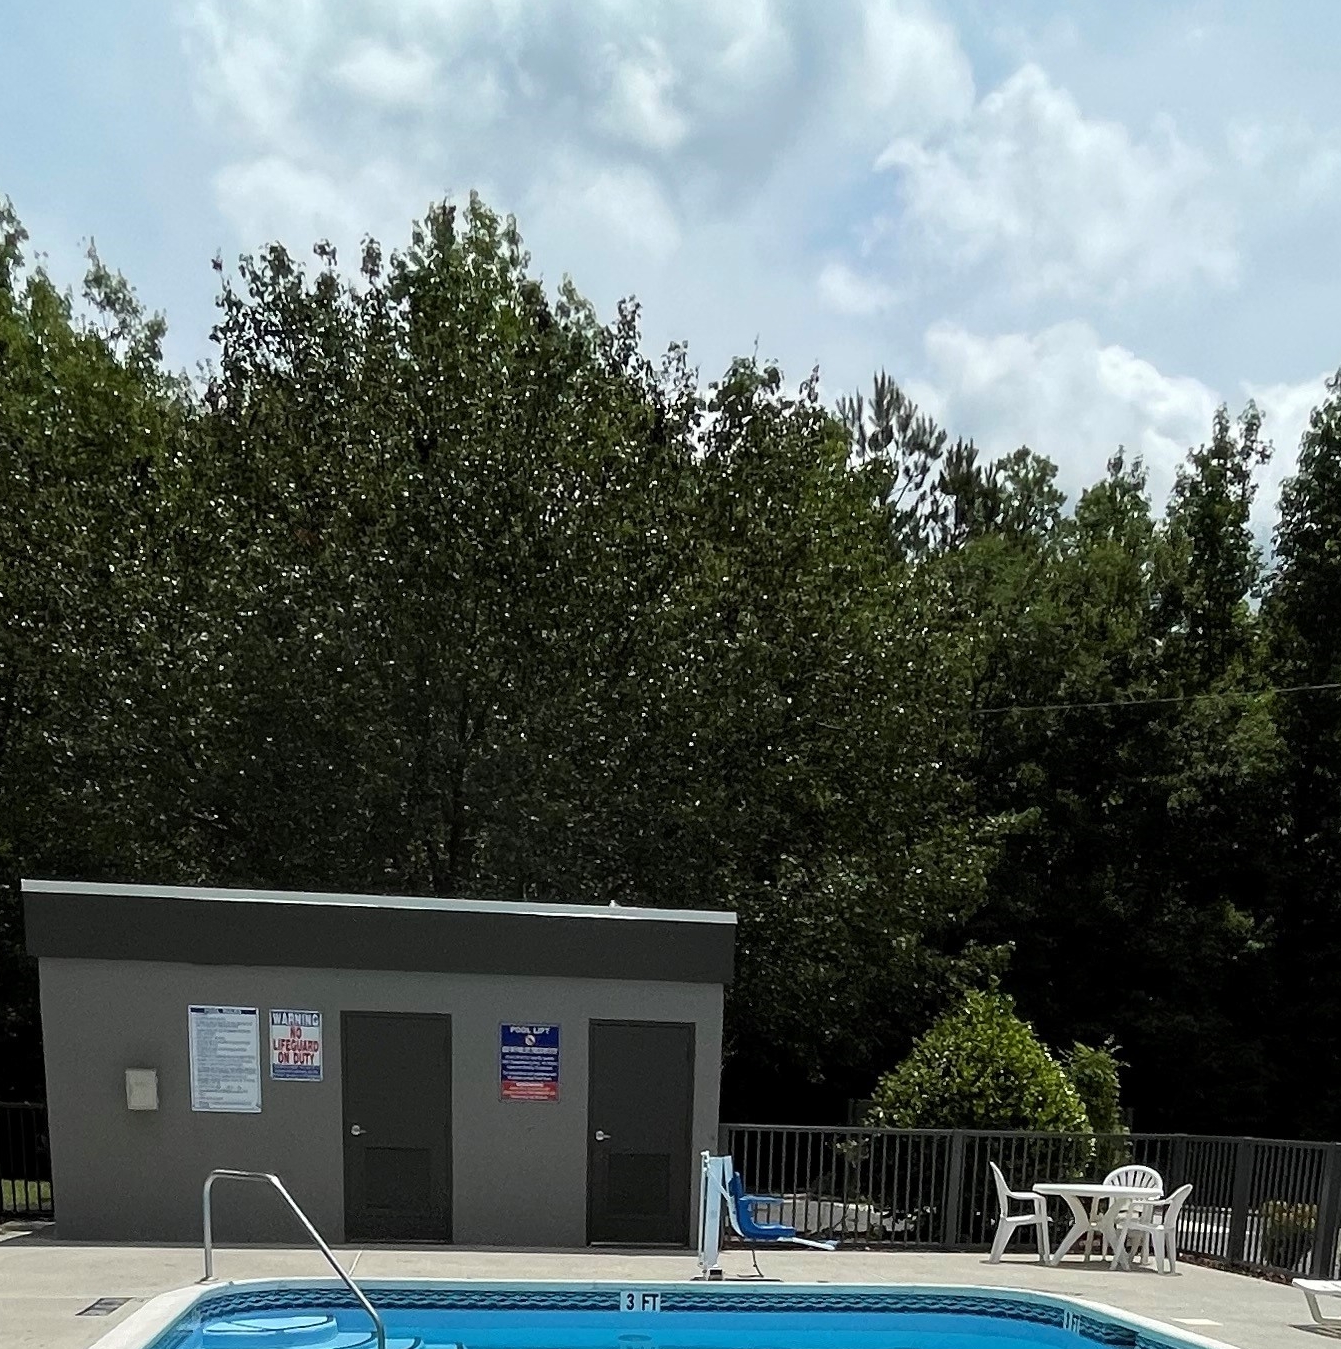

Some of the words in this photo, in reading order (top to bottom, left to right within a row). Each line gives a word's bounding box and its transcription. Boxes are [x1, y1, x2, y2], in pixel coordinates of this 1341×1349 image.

[272, 1012, 319, 1026] WARNING
[290, 1026, 302, 1039] NO
[273, 1039, 319, 1053] LIFEGUARD
[277, 1051, 290, 1064] ON
[293, 1052, 315, 1065] DUTY
[626, 1293, 635, 1311] 3
[641, 1293, 659, 1311] FT
